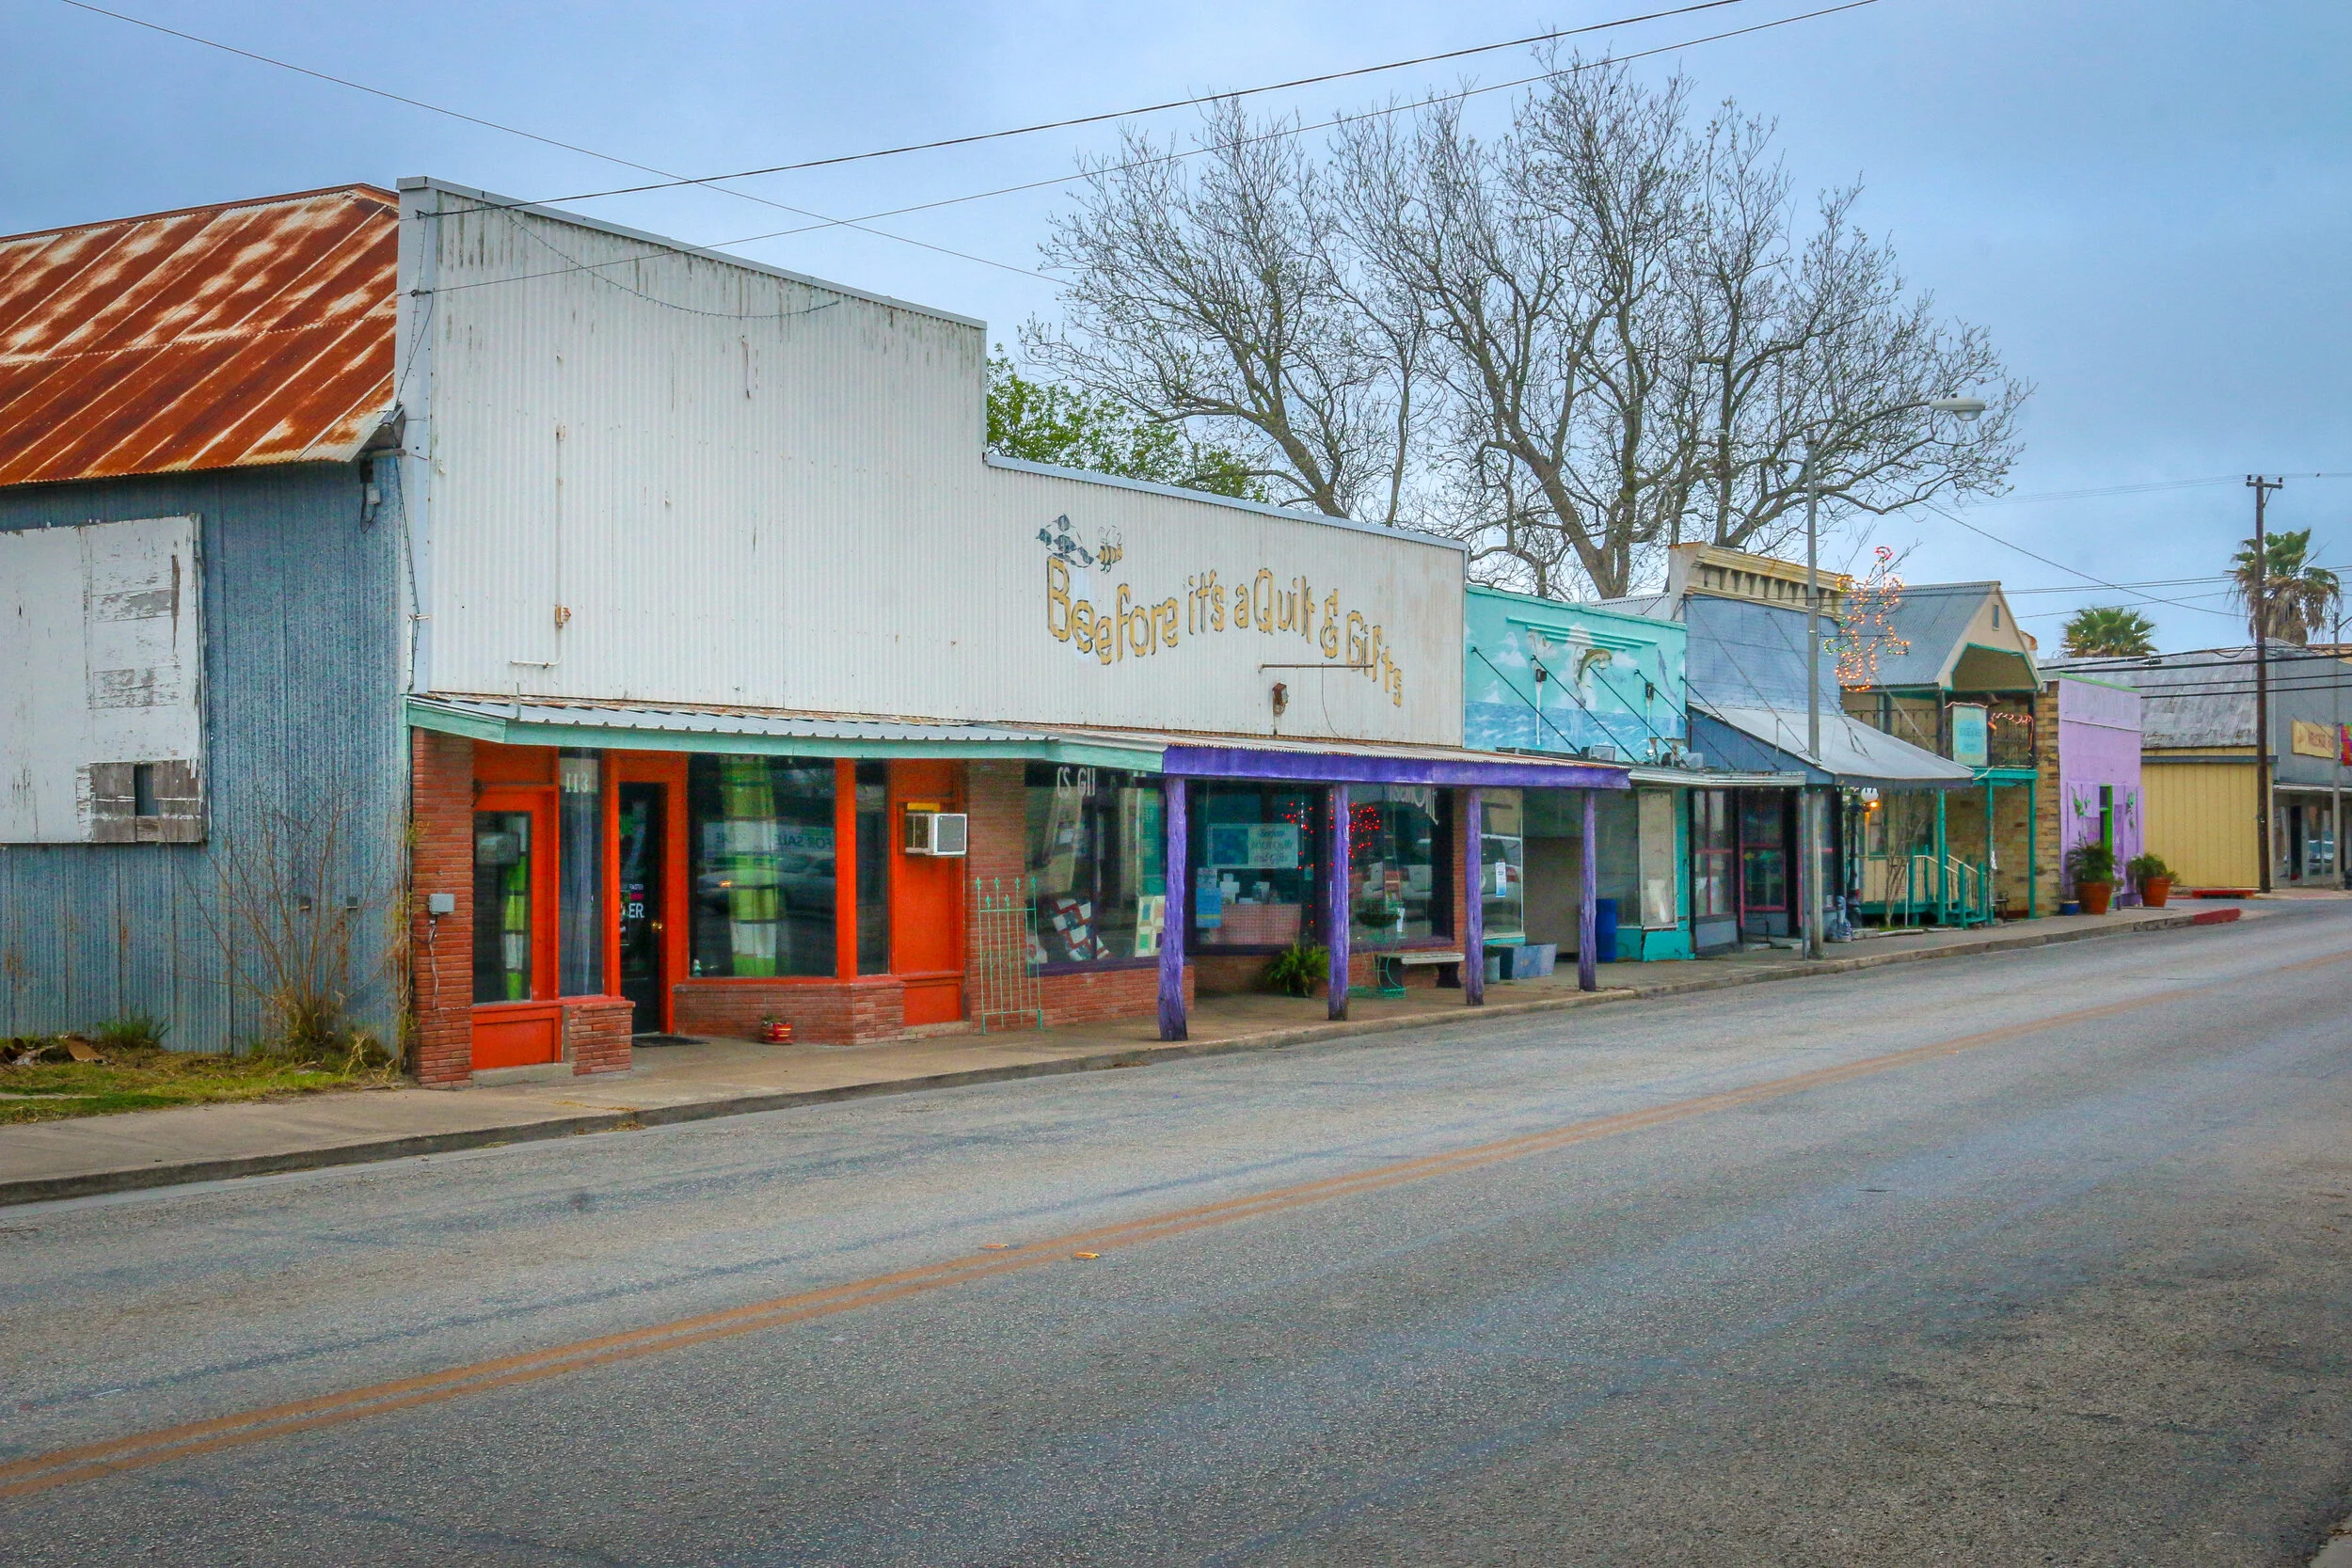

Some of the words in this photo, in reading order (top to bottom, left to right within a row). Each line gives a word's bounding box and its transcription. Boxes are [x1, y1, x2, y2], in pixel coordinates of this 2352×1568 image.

[1046, 555, 1180, 666] Beefore
[1188, 568, 1225, 635] it's
[1233, 583, 1249, 629] a
[1253, 567, 1316, 643] Quilt
[1345, 610, 1403, 707] Gifts
[565, 772, 589, 793] 113
